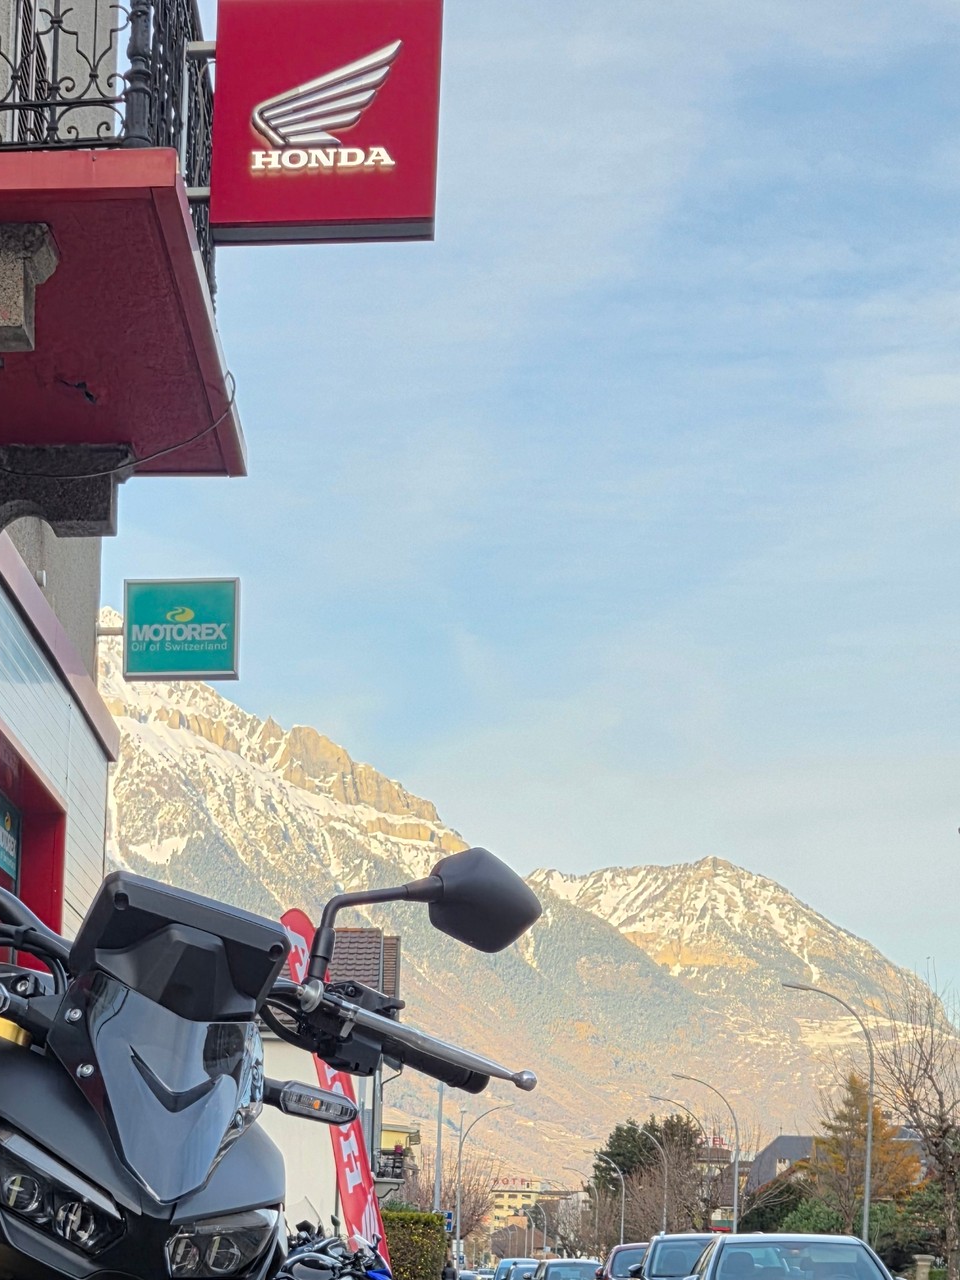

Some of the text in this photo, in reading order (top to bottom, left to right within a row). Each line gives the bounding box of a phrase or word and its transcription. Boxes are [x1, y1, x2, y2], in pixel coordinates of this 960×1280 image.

[251, 147, 395, 170] HONDA
[131, 623, 228, 642] MOTOREX
[131, 641, 228, 652] Oil of Switzerland
